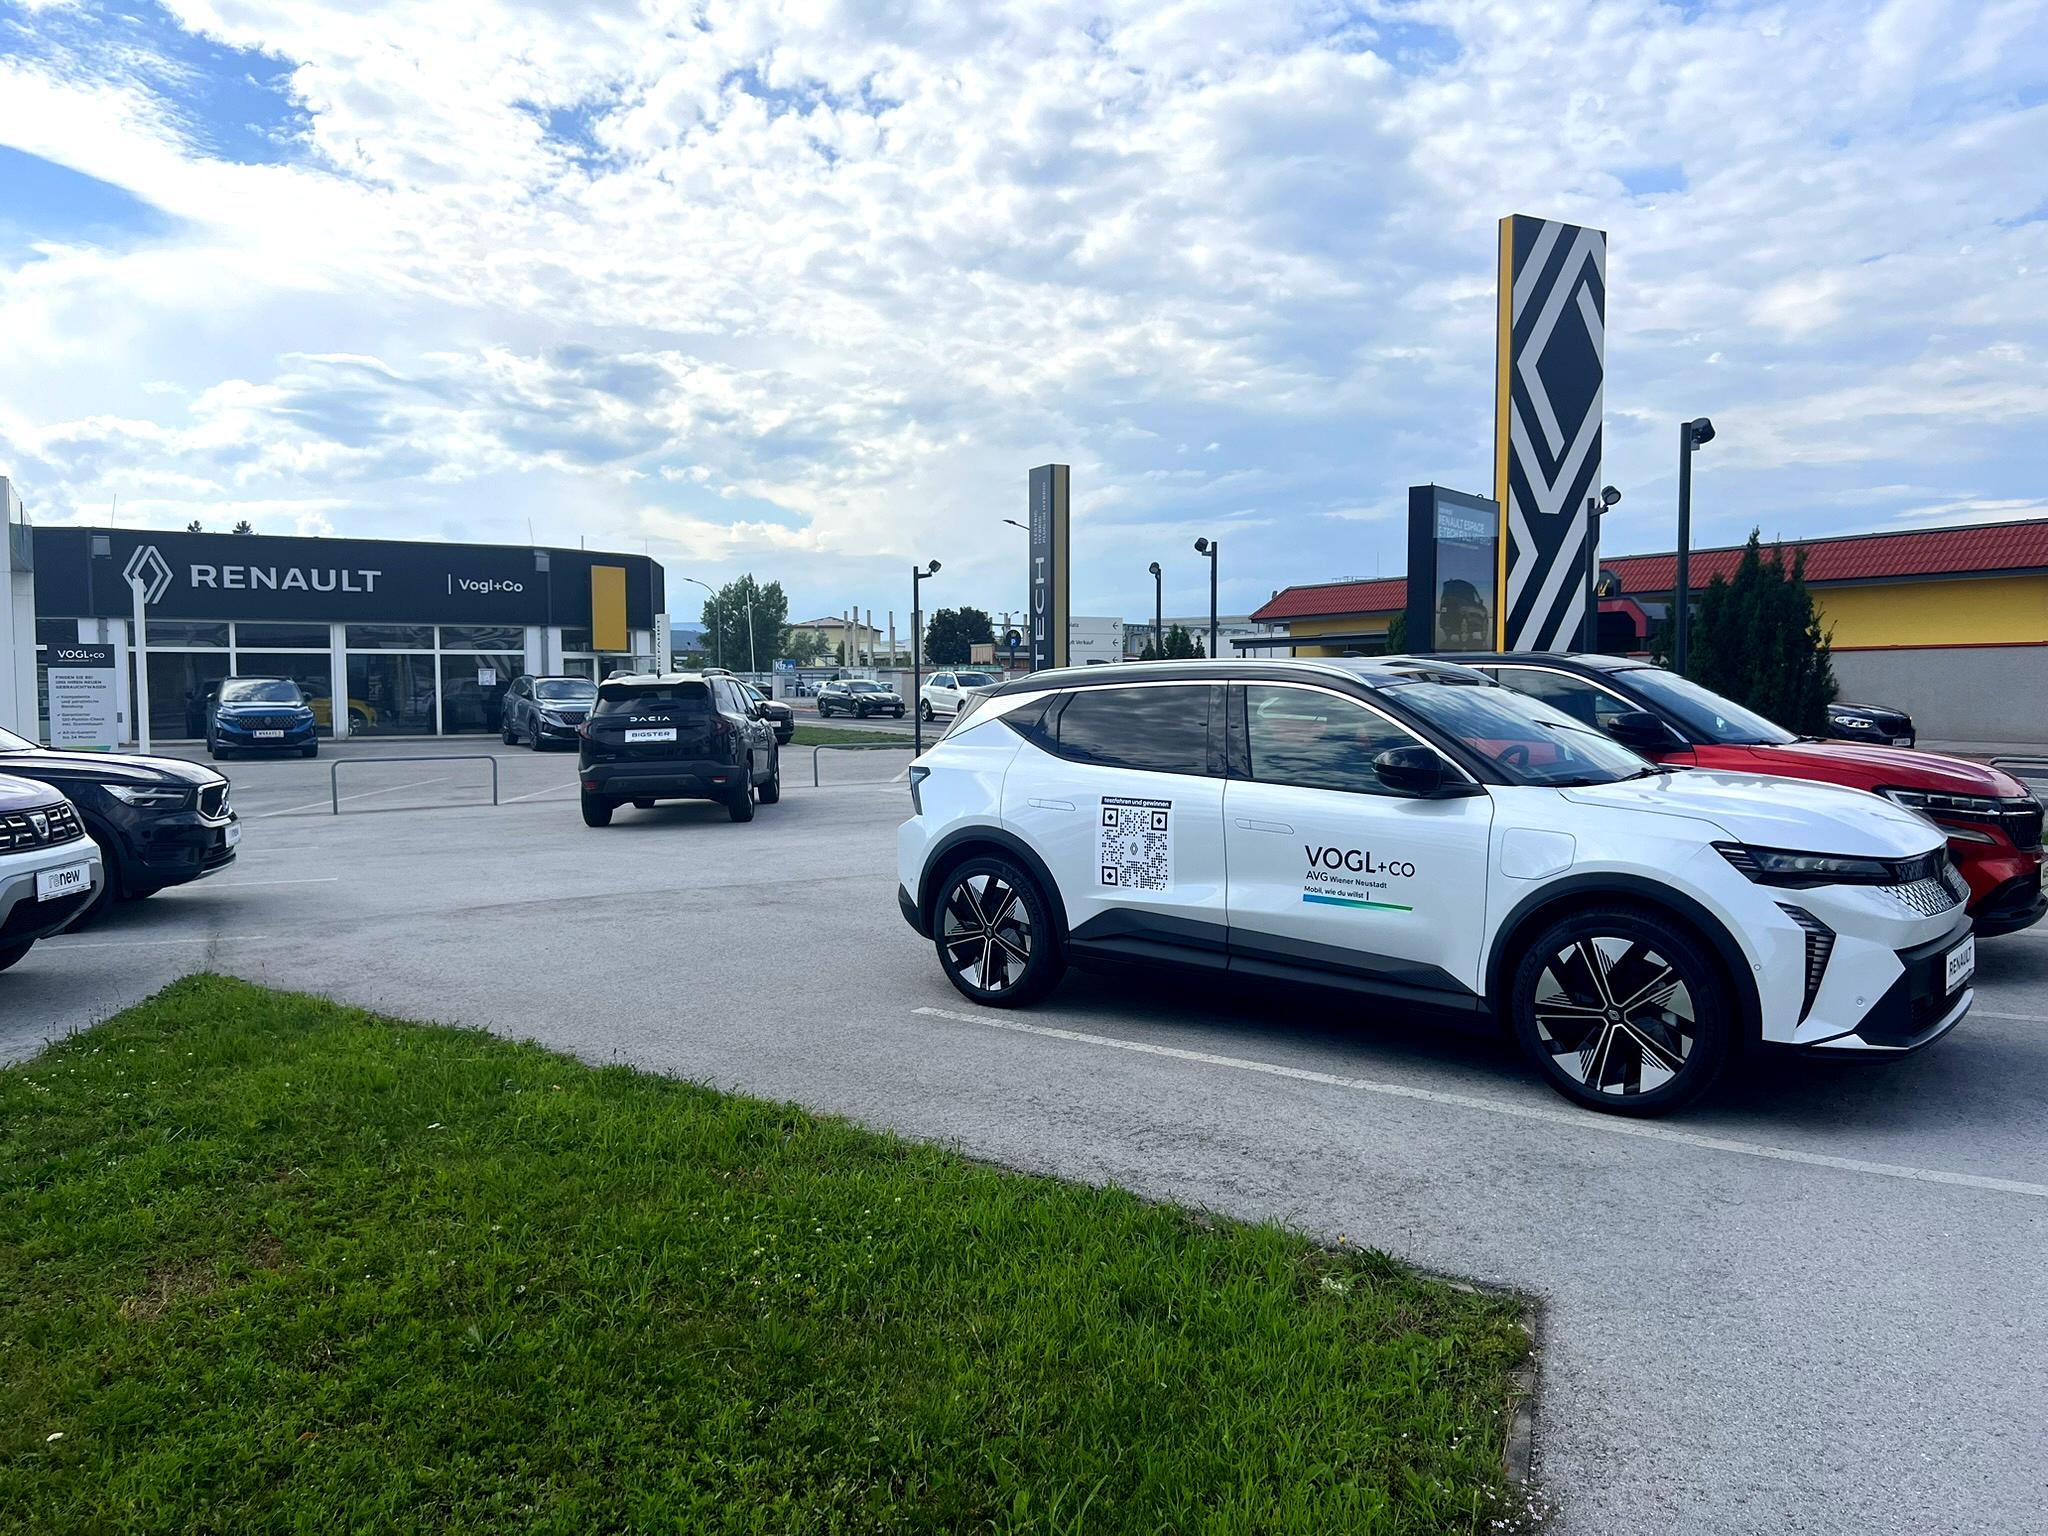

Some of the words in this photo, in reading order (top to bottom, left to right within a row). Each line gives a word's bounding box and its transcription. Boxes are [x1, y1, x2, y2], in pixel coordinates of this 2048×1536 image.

[190, 564, 382, 593] RENAULT
[459, 578, 524, 594] Vogl+Co
[631, 731, 671, 739] BIGSTER
[1104, 797, 1132, 805] testfahren
[48, 869, 81, 889] renew
[1305, 870, 1329, 882] AVG
[1329, 875, 1354, 885] Wiener
[1355, 879, 1388, 889] Neustadt
[1325, 888, 1337, 896] wie
[1336, 889, 1346, 897] du
[1346, 890, 1364, 899] willst
[1949, 945, 1973, 977] RENAULT
